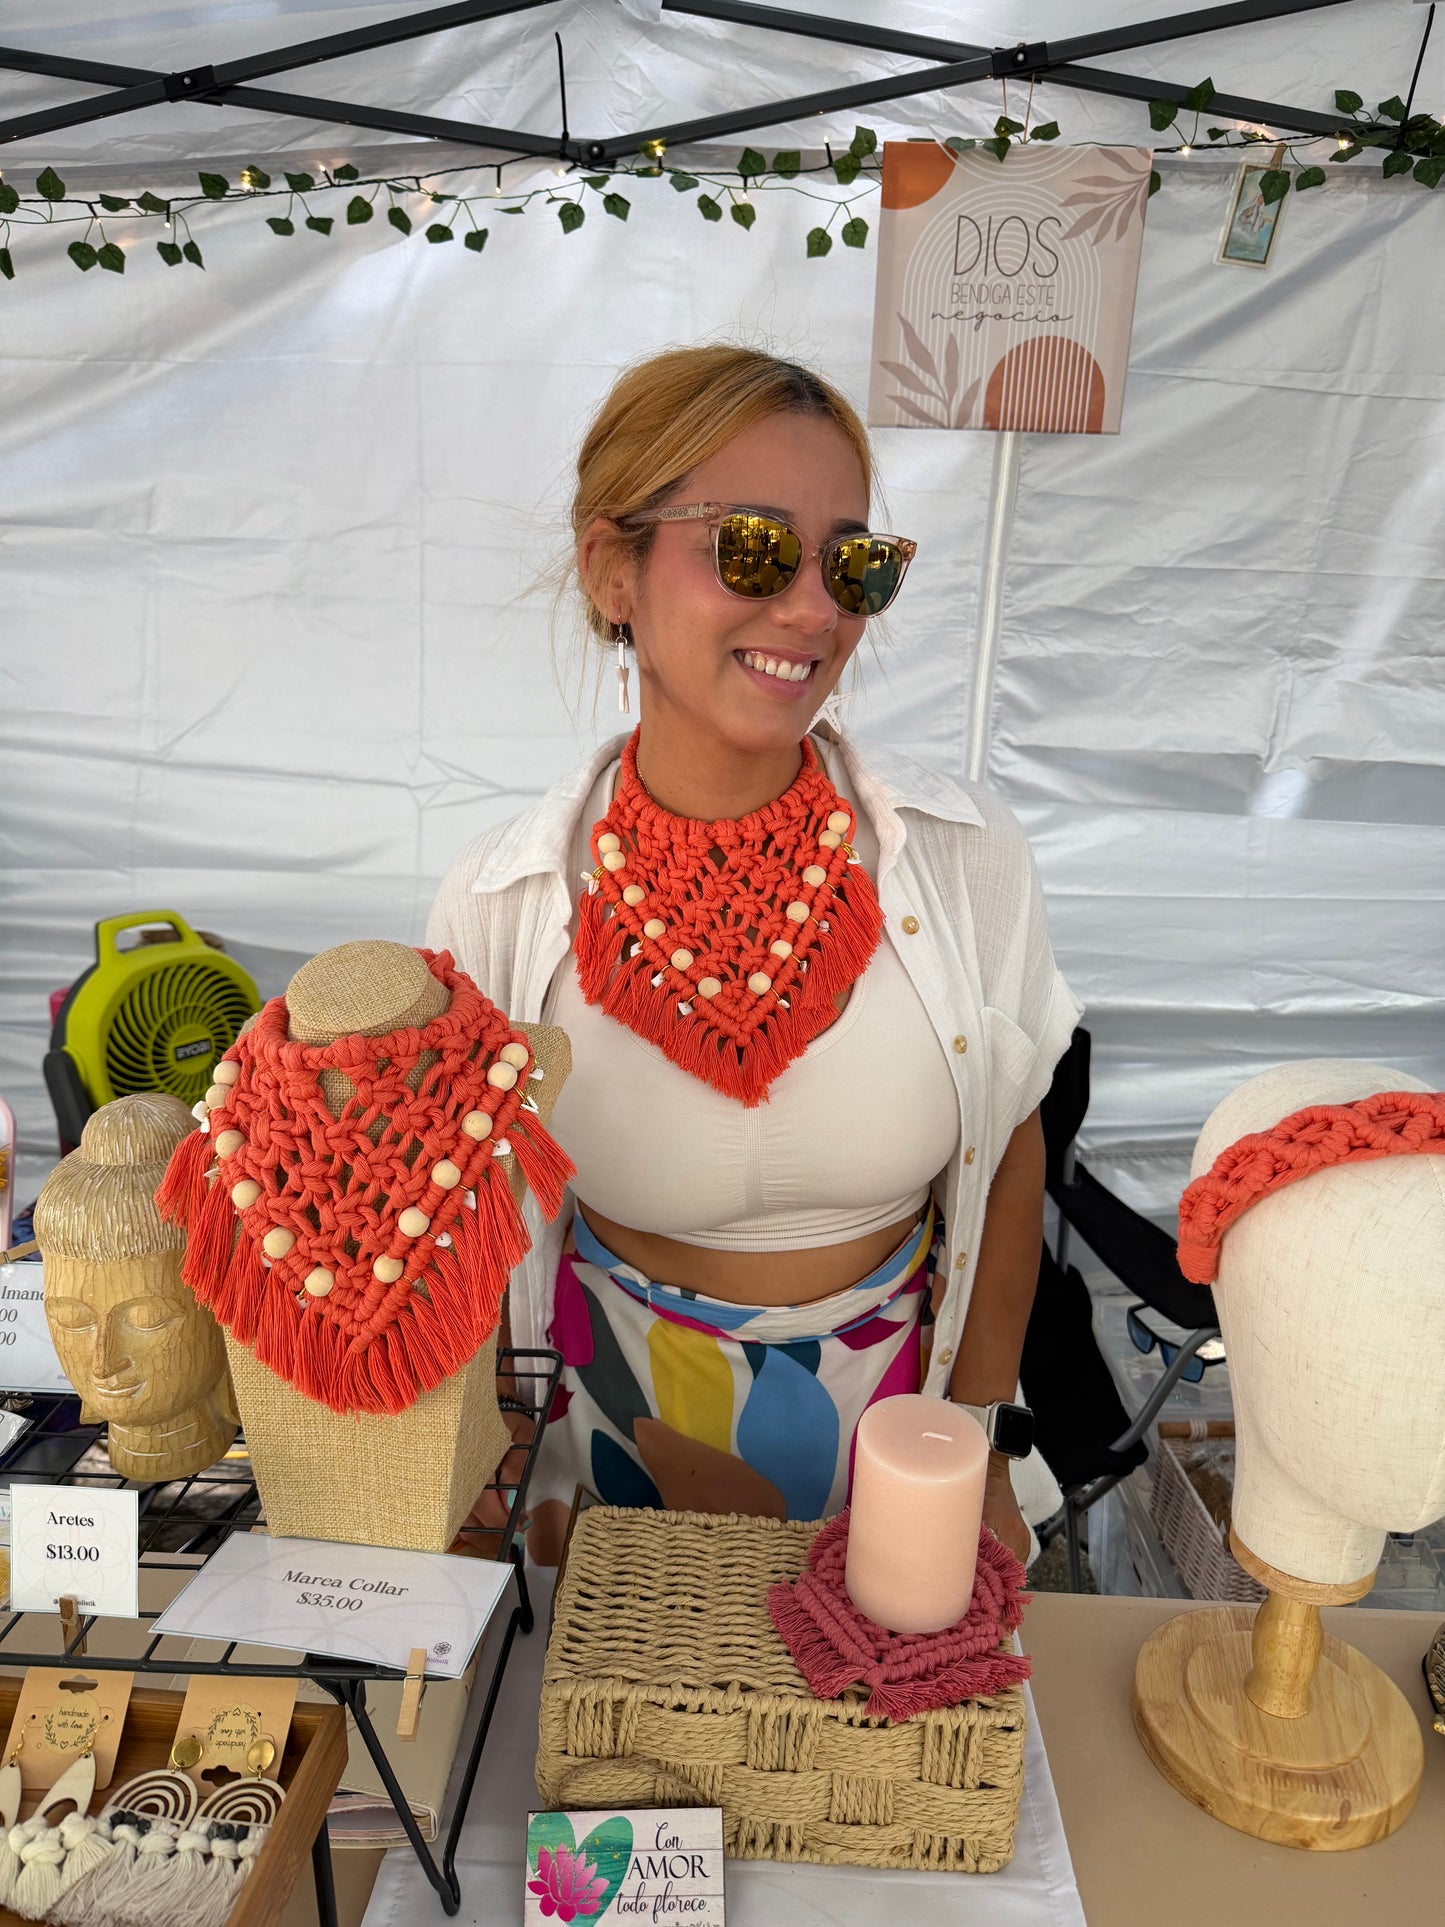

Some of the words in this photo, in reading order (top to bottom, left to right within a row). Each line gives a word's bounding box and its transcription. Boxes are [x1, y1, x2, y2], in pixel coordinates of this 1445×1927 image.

[953, 214, 1062, 278] DIOS
[951, 282, 1011, 305] BENDIGA
[1016, 284, 1055, 306] ESTE
[931, 309, 1073, 332] negocio
[47, 1512, 95, 1527] Aretes
[46, 1543, 100, 1562] $13.00
[349, 1577, 409, 1597] Collar
[296, 1591, 363, 1611] $35.00
[59, 1706, 90, 1718] handmade
[655, 1822, 683, 1850] Con
[627, 1855, 709, 1880] AMOR
[616, 1881, 648, 1915] todo
[652, 1881, 711, 1923] florece.
